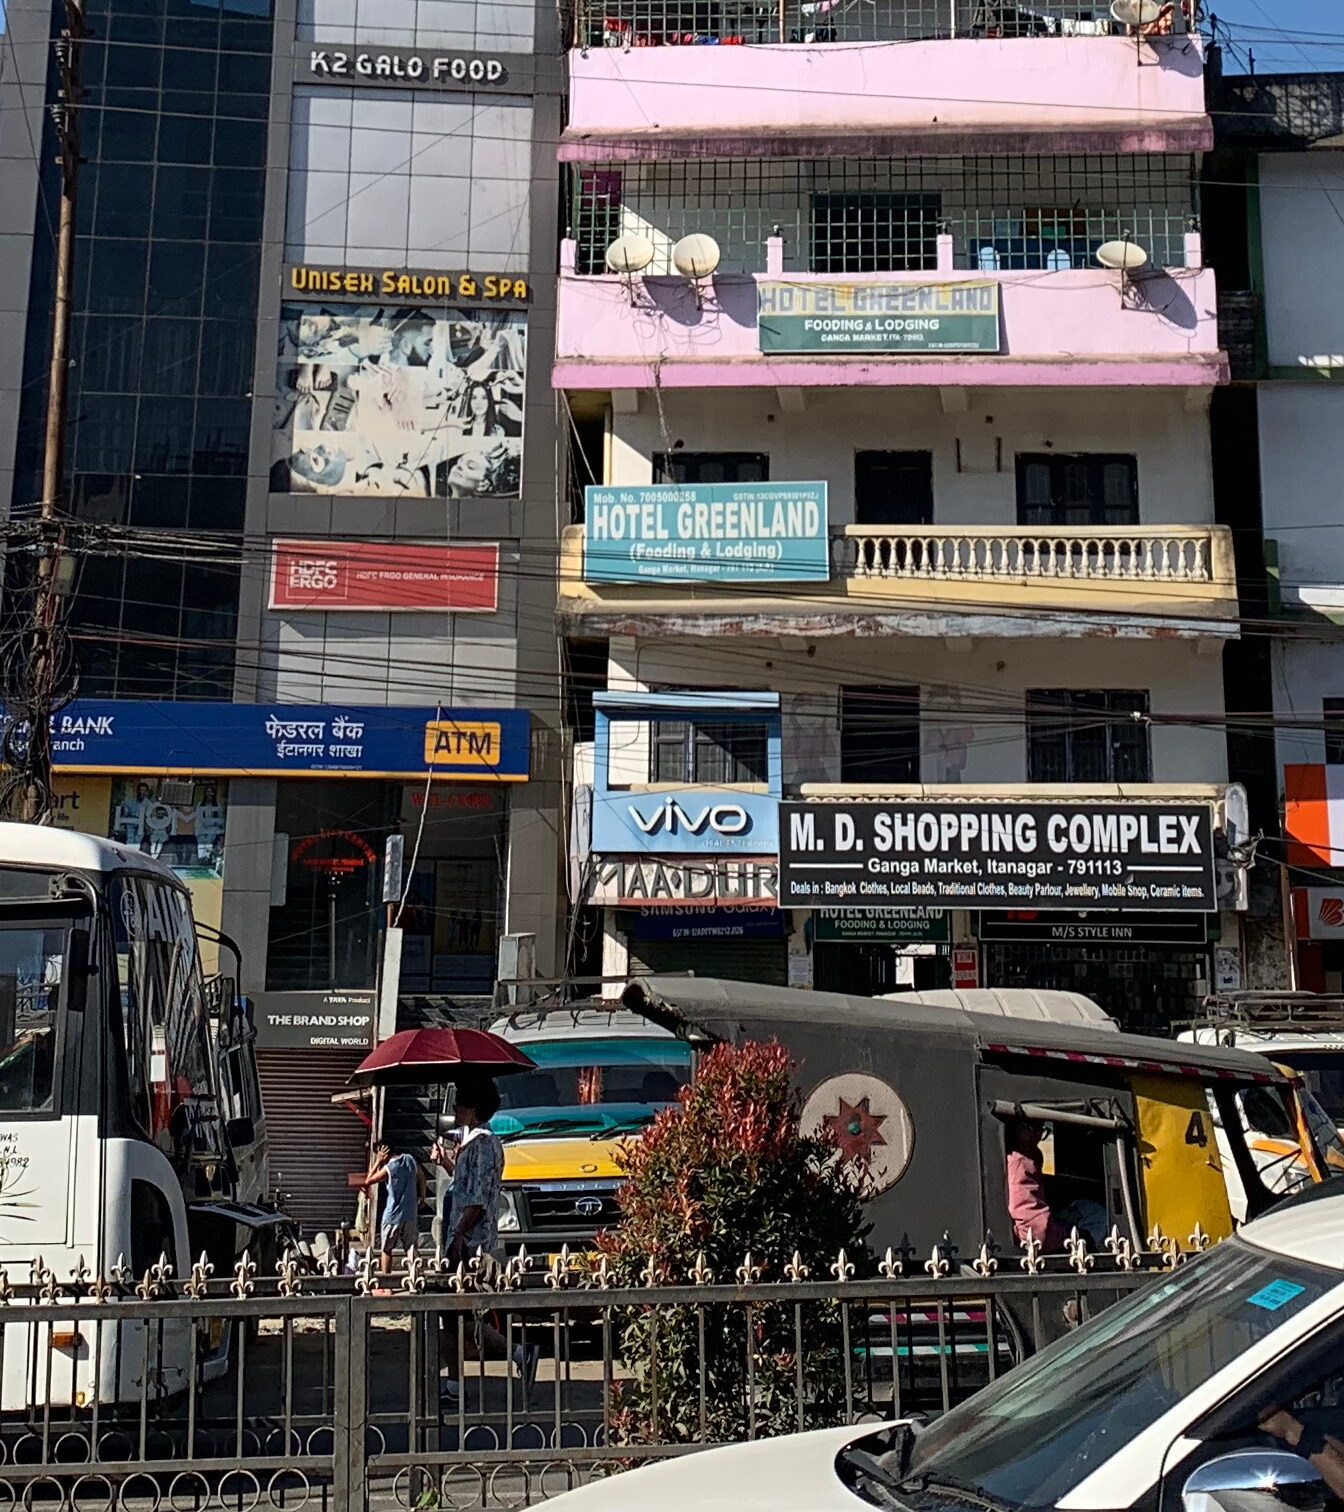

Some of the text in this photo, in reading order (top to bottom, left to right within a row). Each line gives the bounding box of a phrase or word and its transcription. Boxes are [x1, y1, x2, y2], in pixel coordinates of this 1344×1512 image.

[310, 51, 502, 81] K2 GALO FOOD
[381, 272, 449, 295] SALON
[458, 275, 476, 295] &
[484, 276, 526, 298] SPA
[761, 287, 992, 312] HOTEL GREENLAND
[805, 319, 863, 331] FOODING
[875, 318, 940, 330] LODGING
[821, 334, 852, 342] GANGA
[593, 494, 615, 504] Mob.
[620, 493, 637, 503] No.
[734, 492, 755, 501] GSTIN
[593, 501, 820, 541] HOTEL GREENLAND
[630, 540, 783, 561] (Fooding & Lodging)
[290, 559, 338, 589] HDFC ERGO
[379, 571, 402, 580] ERGO
[403, 571, 440, 581] GENERAL
[639, 565, 661, 575] Ganga
[61, 716, 115, 736] BANK
[265, 714, 365, 740] फेडरल बैंक
[276, 740, 363, 759] ईटानगर शाखा
[434, 730, 492, 755] ATM
[115, 802, 227, 837] HOME
[628, 796, 747, 832] vivo
[790, 812, 1203, 854] M. D. SHOPPING COMPLEX
[868, 858, 920, 877] Ganga
[924, 858, 983, 877] Market,
[987, 858, 1054, 878] Itanagar
[1067, 859, 1123, 875] 791113
[790, 882, 811, 895] Deals
[812, 882, 820, 894] in
[825, 881, 857, 898] Bangkok
[860, 882, 890, 897] Clothes,
[891, 882, 911, 895] Local
[912, 882, 937, 897] Beads,
[939, 882, 976, 896] Traditional
[977, 883, 1008, 898] Clothes,
[1009, 883, 1034, 899] Beauty
[1035, 883, 1064, 898] Parlour,
[1065, 883, 1101, 900] Jewellery,
[1102, 883, 1126, 897] Mobile
[1128, 884, 1150, 900] Shop,
[1150, 884, 1181, 898] Ceramic
[640, 905, 717, 917] SAMSUNG
[820, 908, 944, 919] HOTEL GREENLAND
[834, 919, 931, 930] FOODING & LODGING
[1052, 926, 1132, 939] M/S STYLE INN
[329, 996, 347, 1004] TATA
[348, 996, 371, 1004] Product
[267, 1014, 370, 1027] THE BRAND SHOP
[310, 1036, 369, 1046] DIGITAL WORLD
[1185, 1111, 1208, 1148] 4
